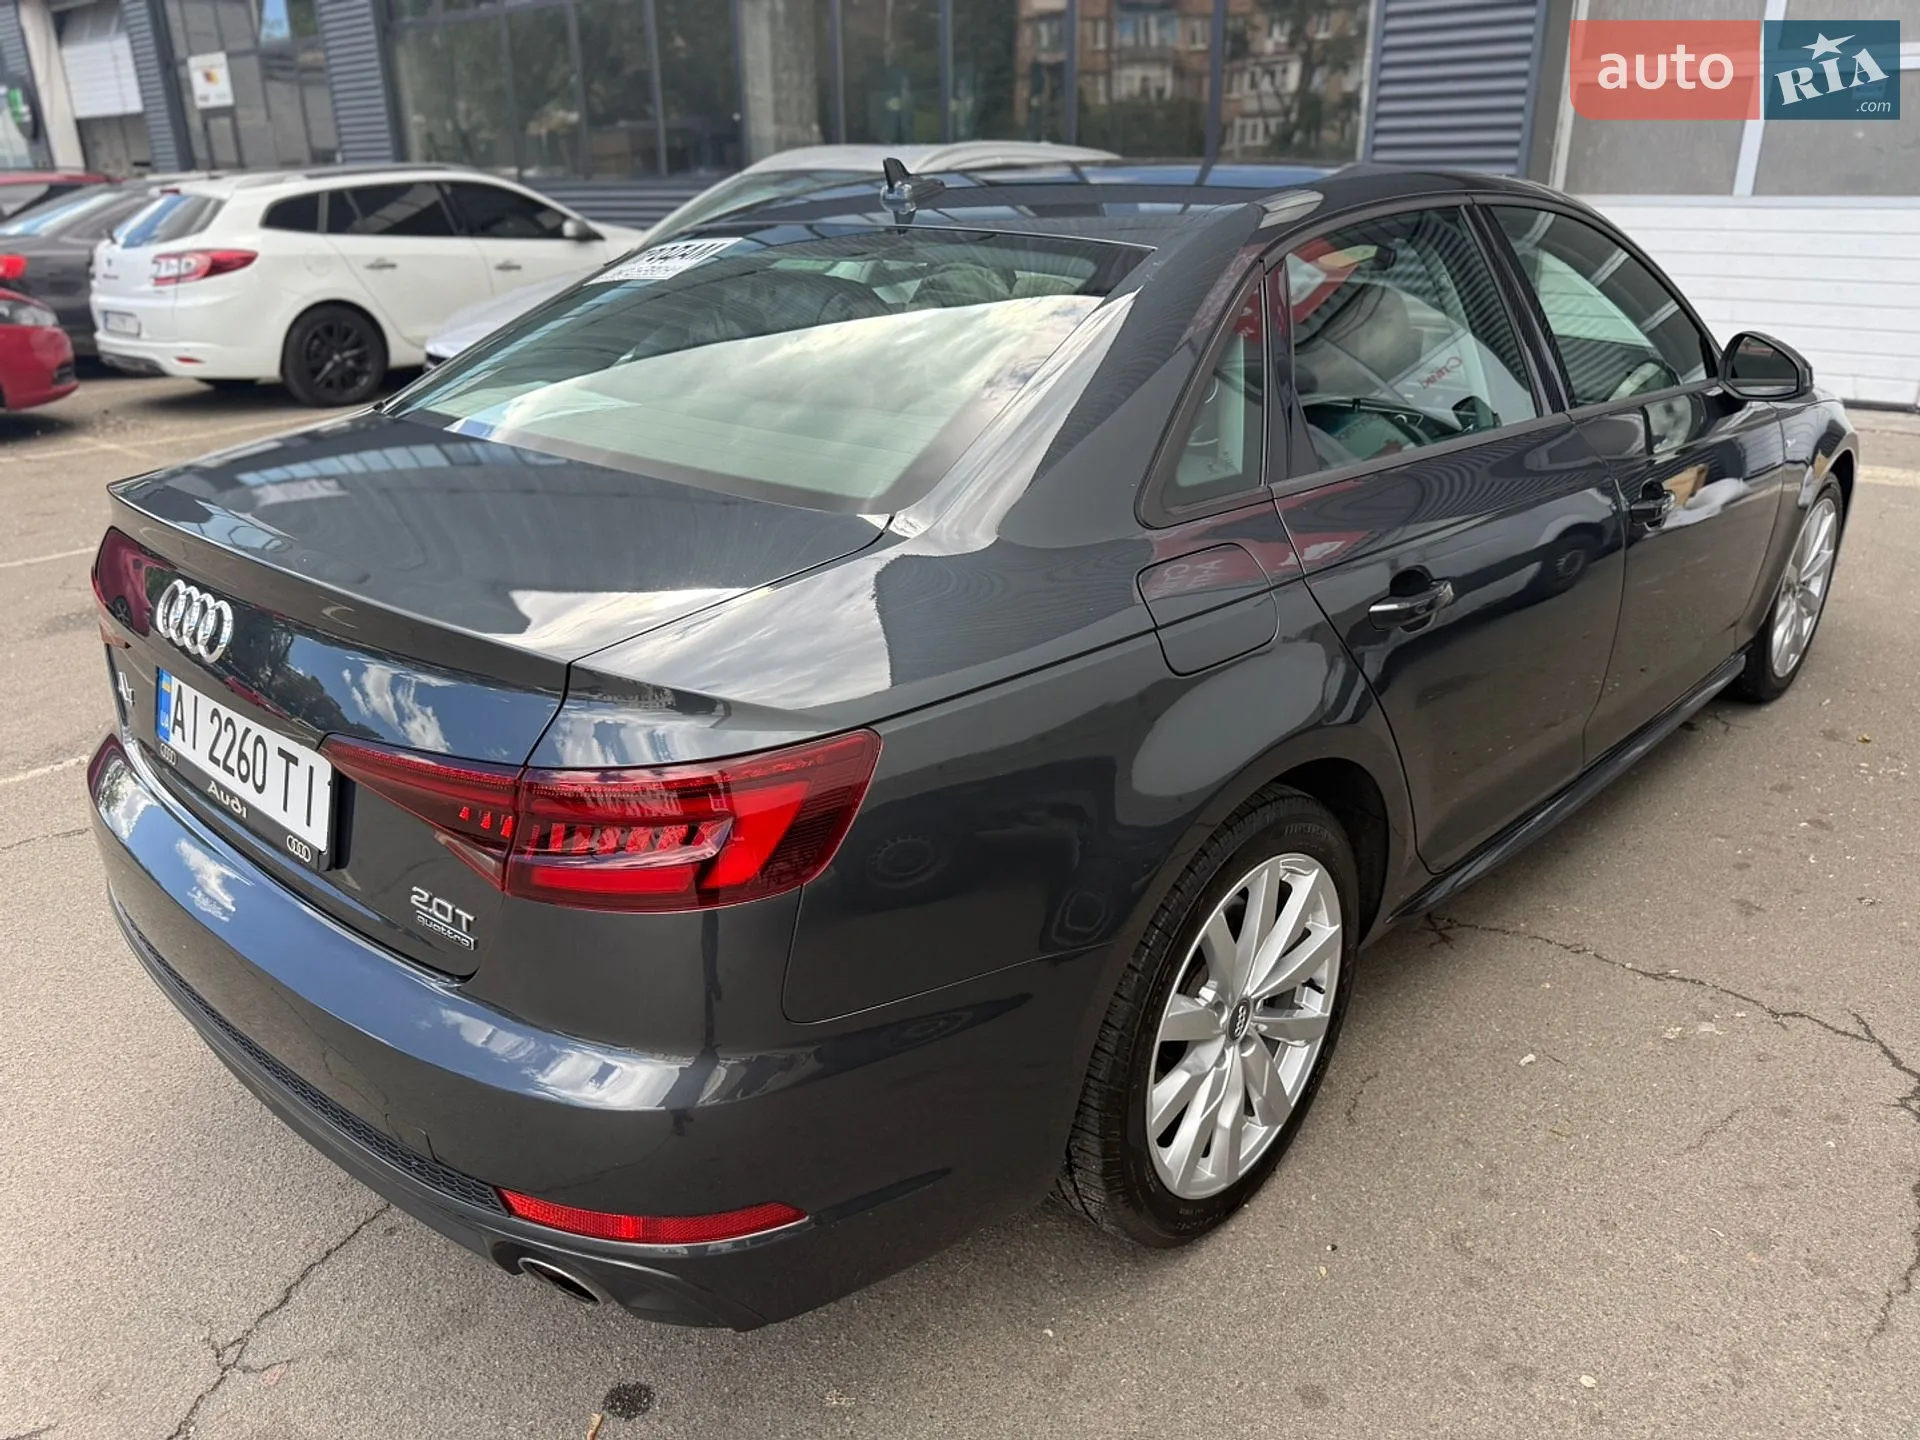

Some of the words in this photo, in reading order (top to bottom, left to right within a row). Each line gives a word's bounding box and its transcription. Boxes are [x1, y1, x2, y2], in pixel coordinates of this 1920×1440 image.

[171, 684, 199, 750] AI
[208, 707, 268, 795] 2260
[277, 746, 314, 828] TI
[207, 780, 248, 820] Audi
[416, 914, 471, 948] quattro
